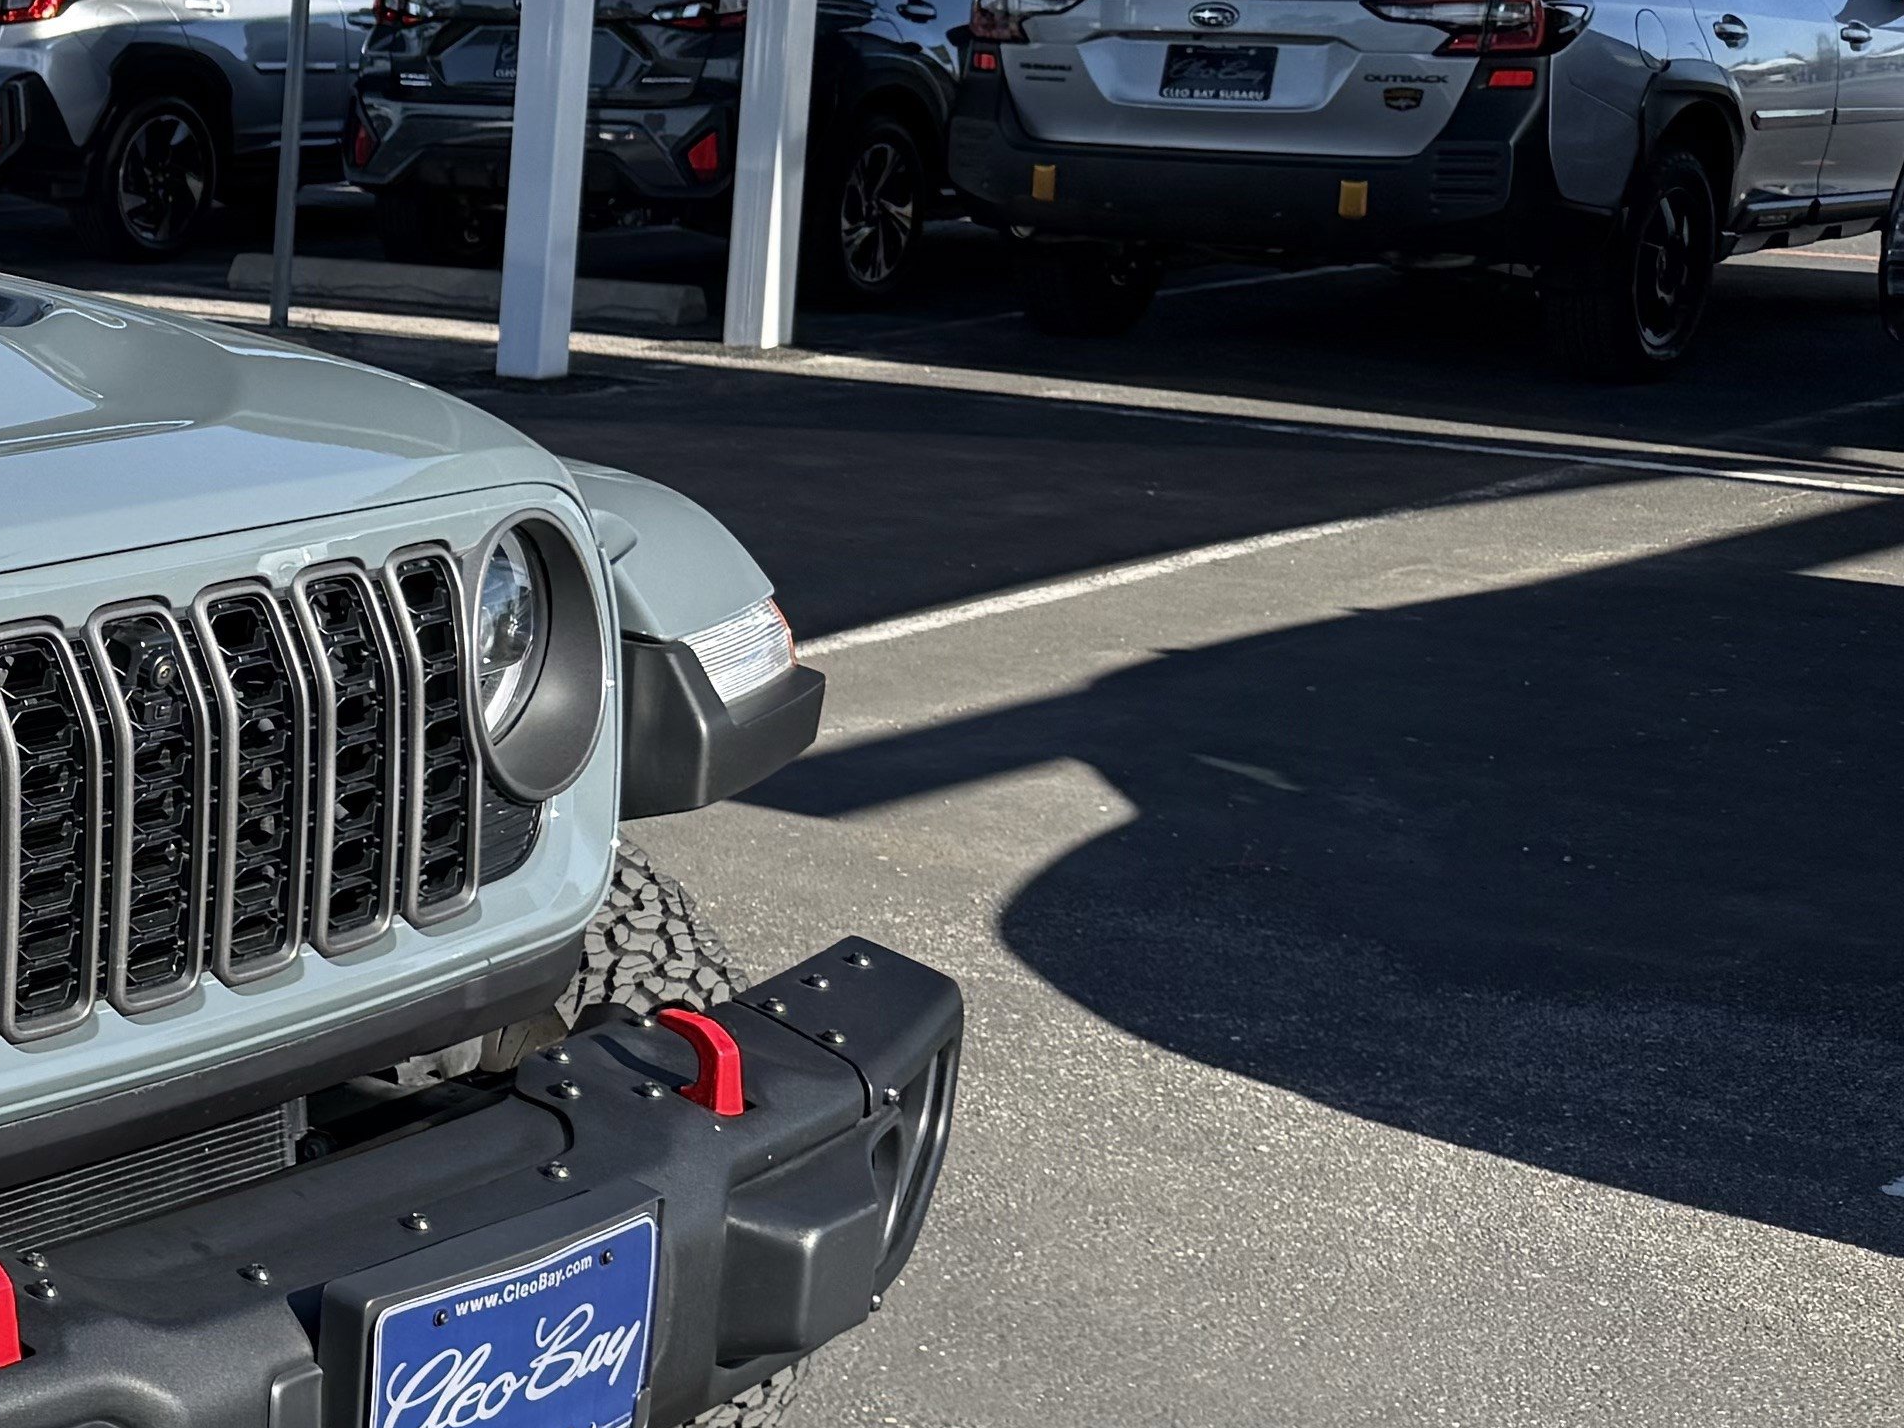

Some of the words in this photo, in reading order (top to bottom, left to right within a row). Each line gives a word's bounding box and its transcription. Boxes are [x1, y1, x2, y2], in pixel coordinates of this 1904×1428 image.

[1162, 88, 1190, 98] CLEO
[1193, 89, 1216, 99] BAY
[1219, 90, 1265, 101] SUBARU
[1364, 74, 1448, 83] OUTBACK
[454, 1254, 593, 1317] www.CleoBay.com
[525, 1303, 641, 1401] Bay
